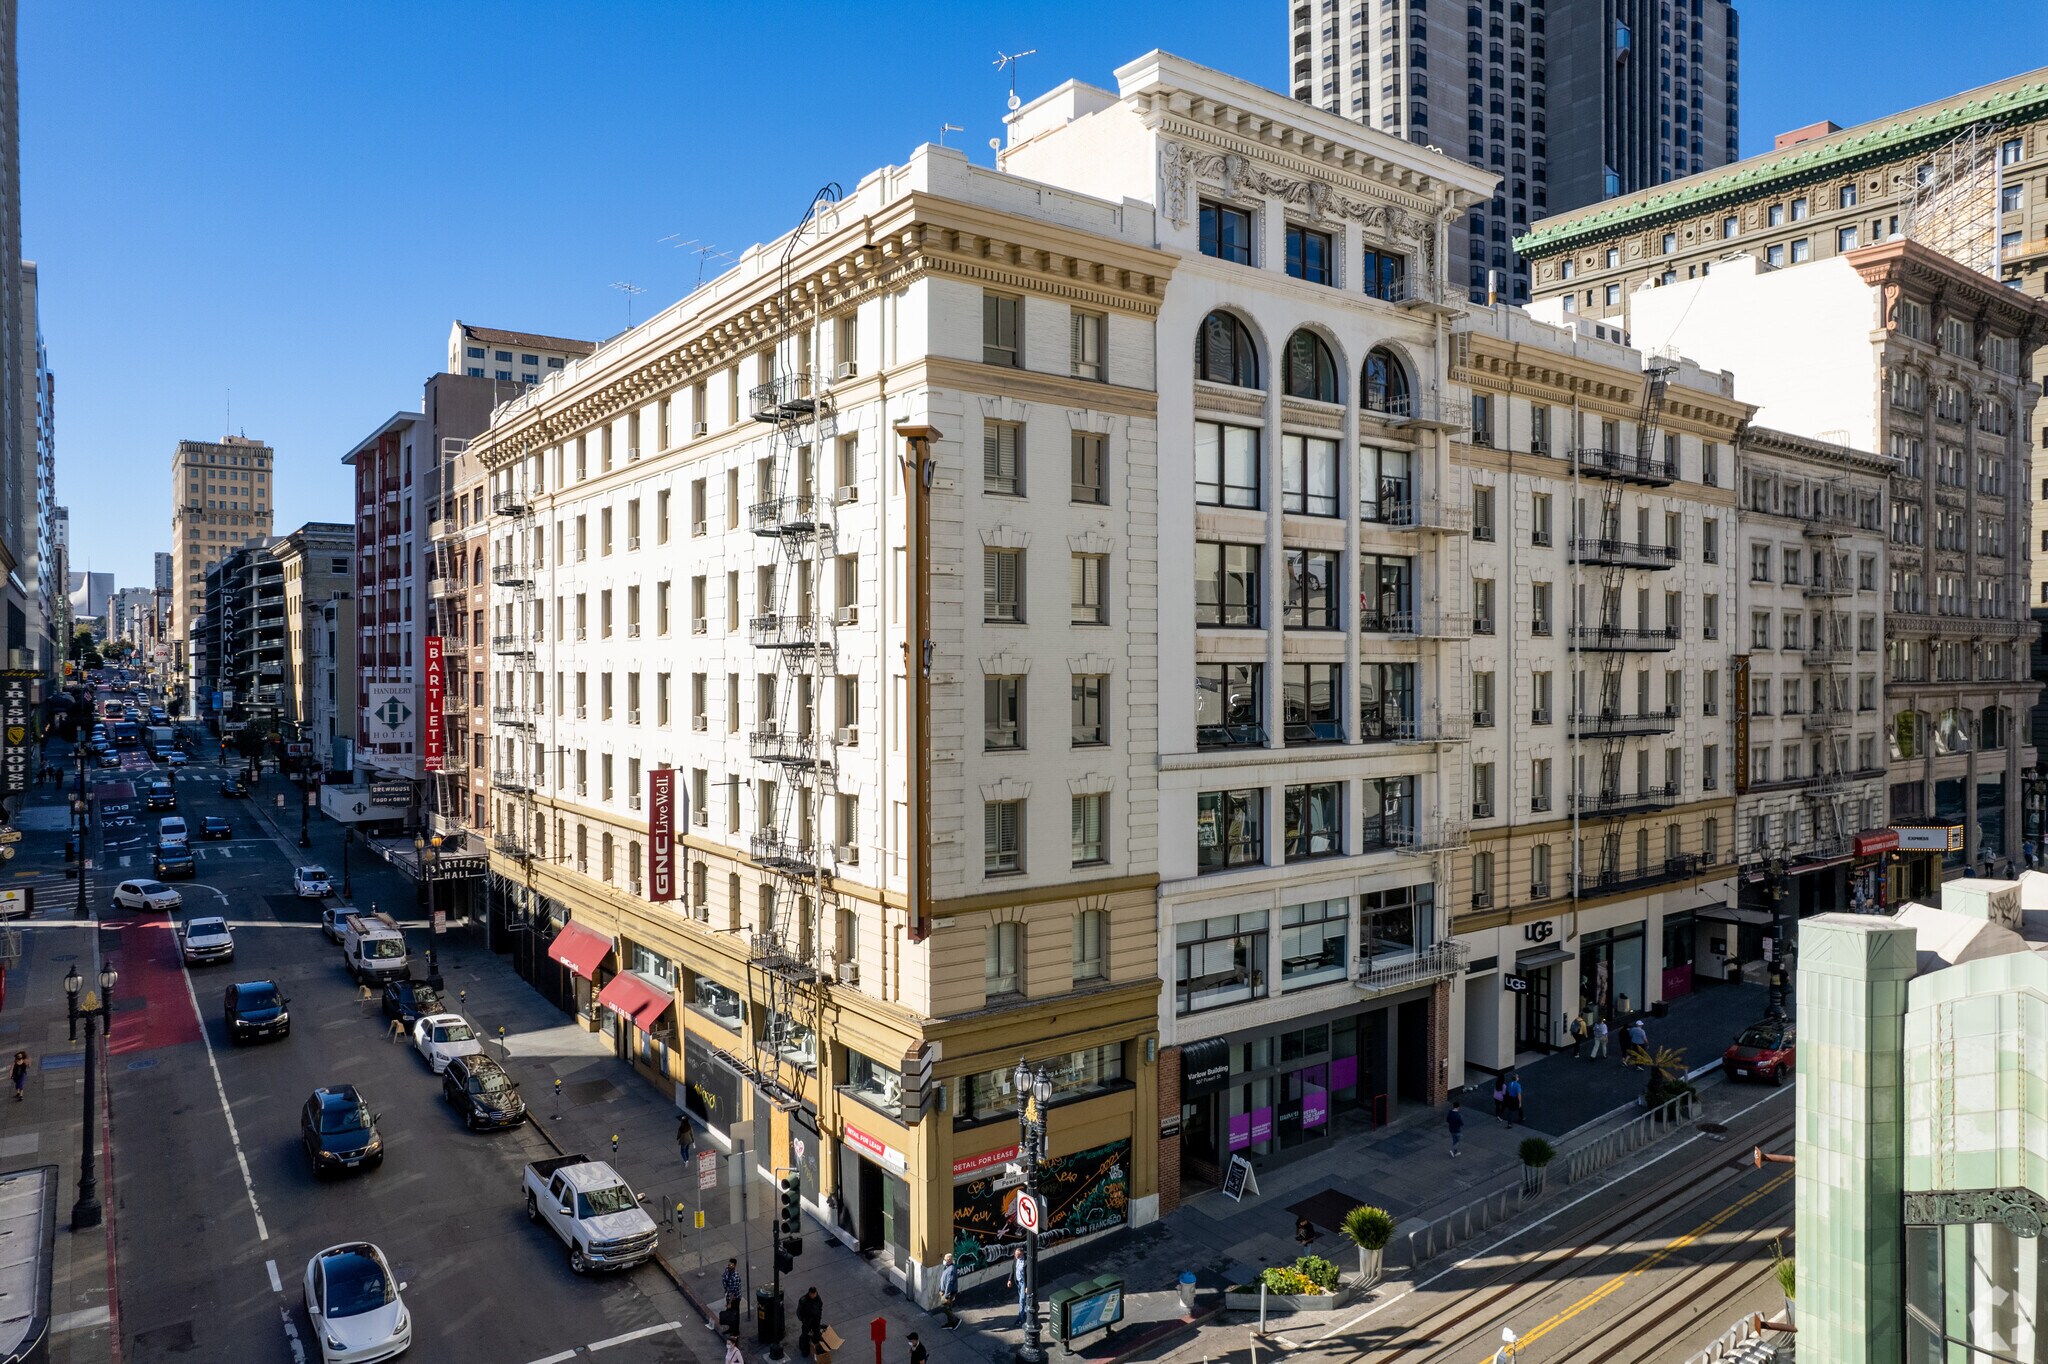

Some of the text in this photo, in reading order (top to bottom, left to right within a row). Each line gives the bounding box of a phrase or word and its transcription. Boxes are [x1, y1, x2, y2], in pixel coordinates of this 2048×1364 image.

[224, 596, 234, 677] PARKING
[429, 648, 440, 754] BARTLETT
[1735, 661, 1749, 784] VILLA FLORENCE
[5, 681, 27, 791] IRISH HOUSE
[101, 819, 135, 828] TAXI
[431, 860, 485, 879] BARTLETT HALL
[655, 836, 669, 895] GNC
[1525, 920, 1553, 942] UGG
[1505, 977, 1526, 990] UGG
[1187, 1065, 1229, 1080] Varlow Building
[860, 1135, 868, 1145] FOR
[953, 1161, 976, 1172] RETAIL
[978, 1156, 992, 1165] FOR
[992, 1150, 1014, 1160] LEASE
[1001, 1177, 1021, 1187] Powell
[953, 1206, 975, 1220] PLAY
